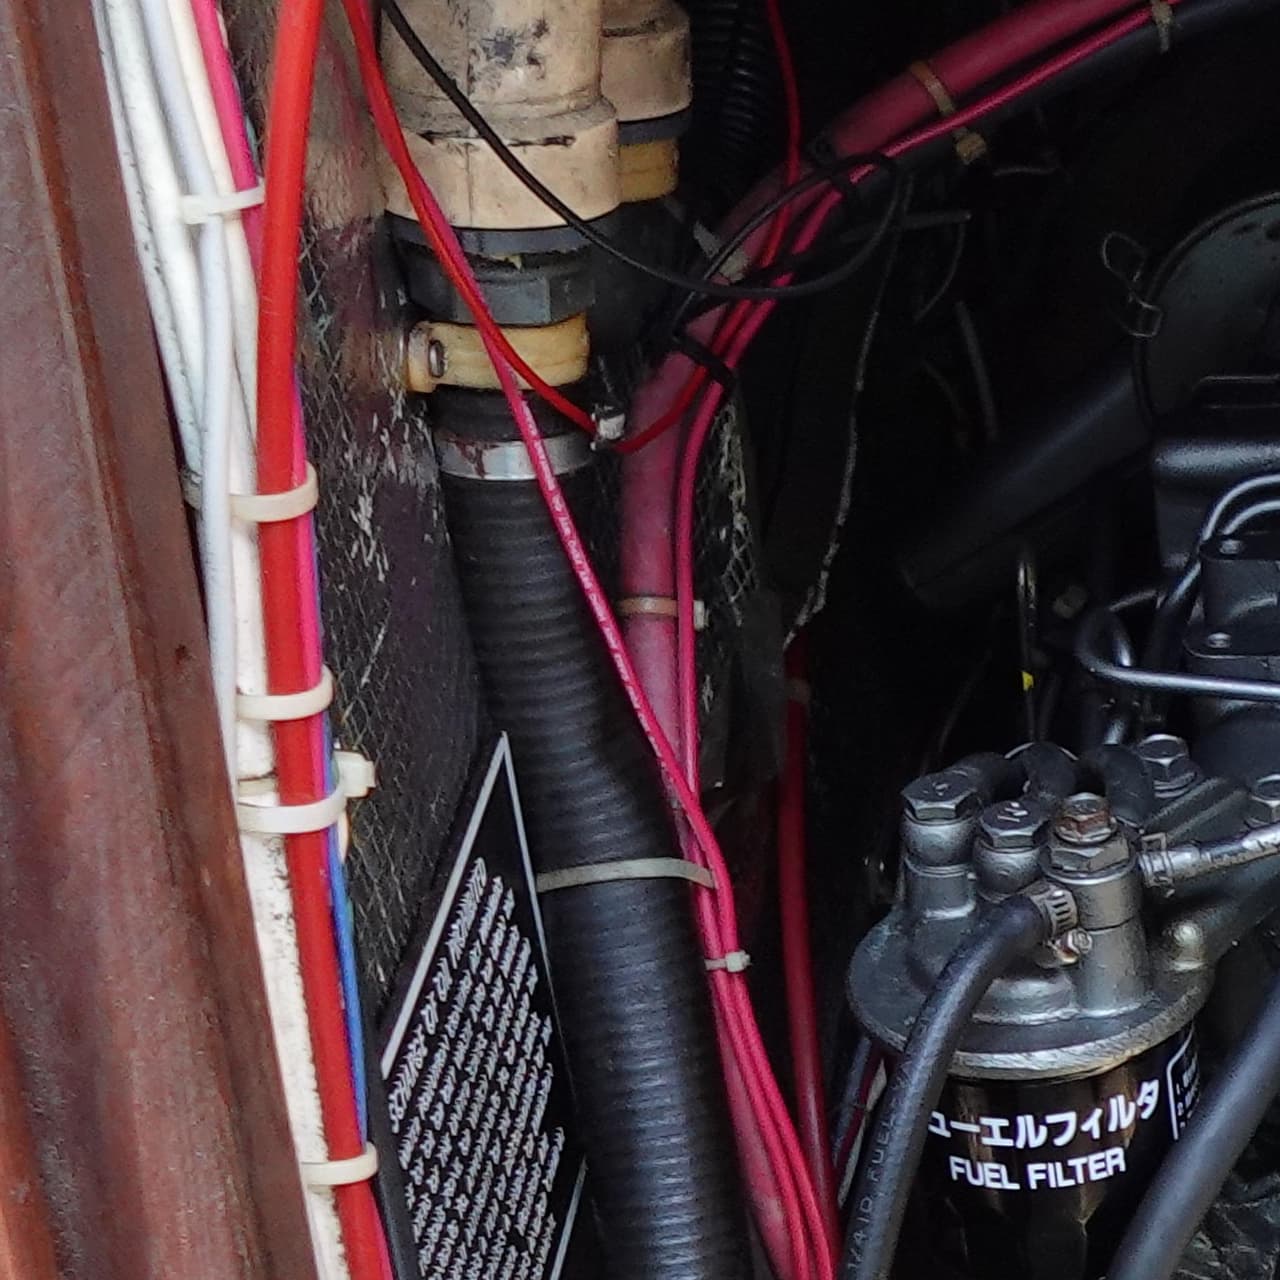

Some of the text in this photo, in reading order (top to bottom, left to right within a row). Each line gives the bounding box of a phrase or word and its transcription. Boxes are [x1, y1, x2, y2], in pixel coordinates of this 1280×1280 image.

[928, 1079, 1160, 1150] ューエルフィルタ
[949, 1147, 1126, 1190] FUEL FILTER
